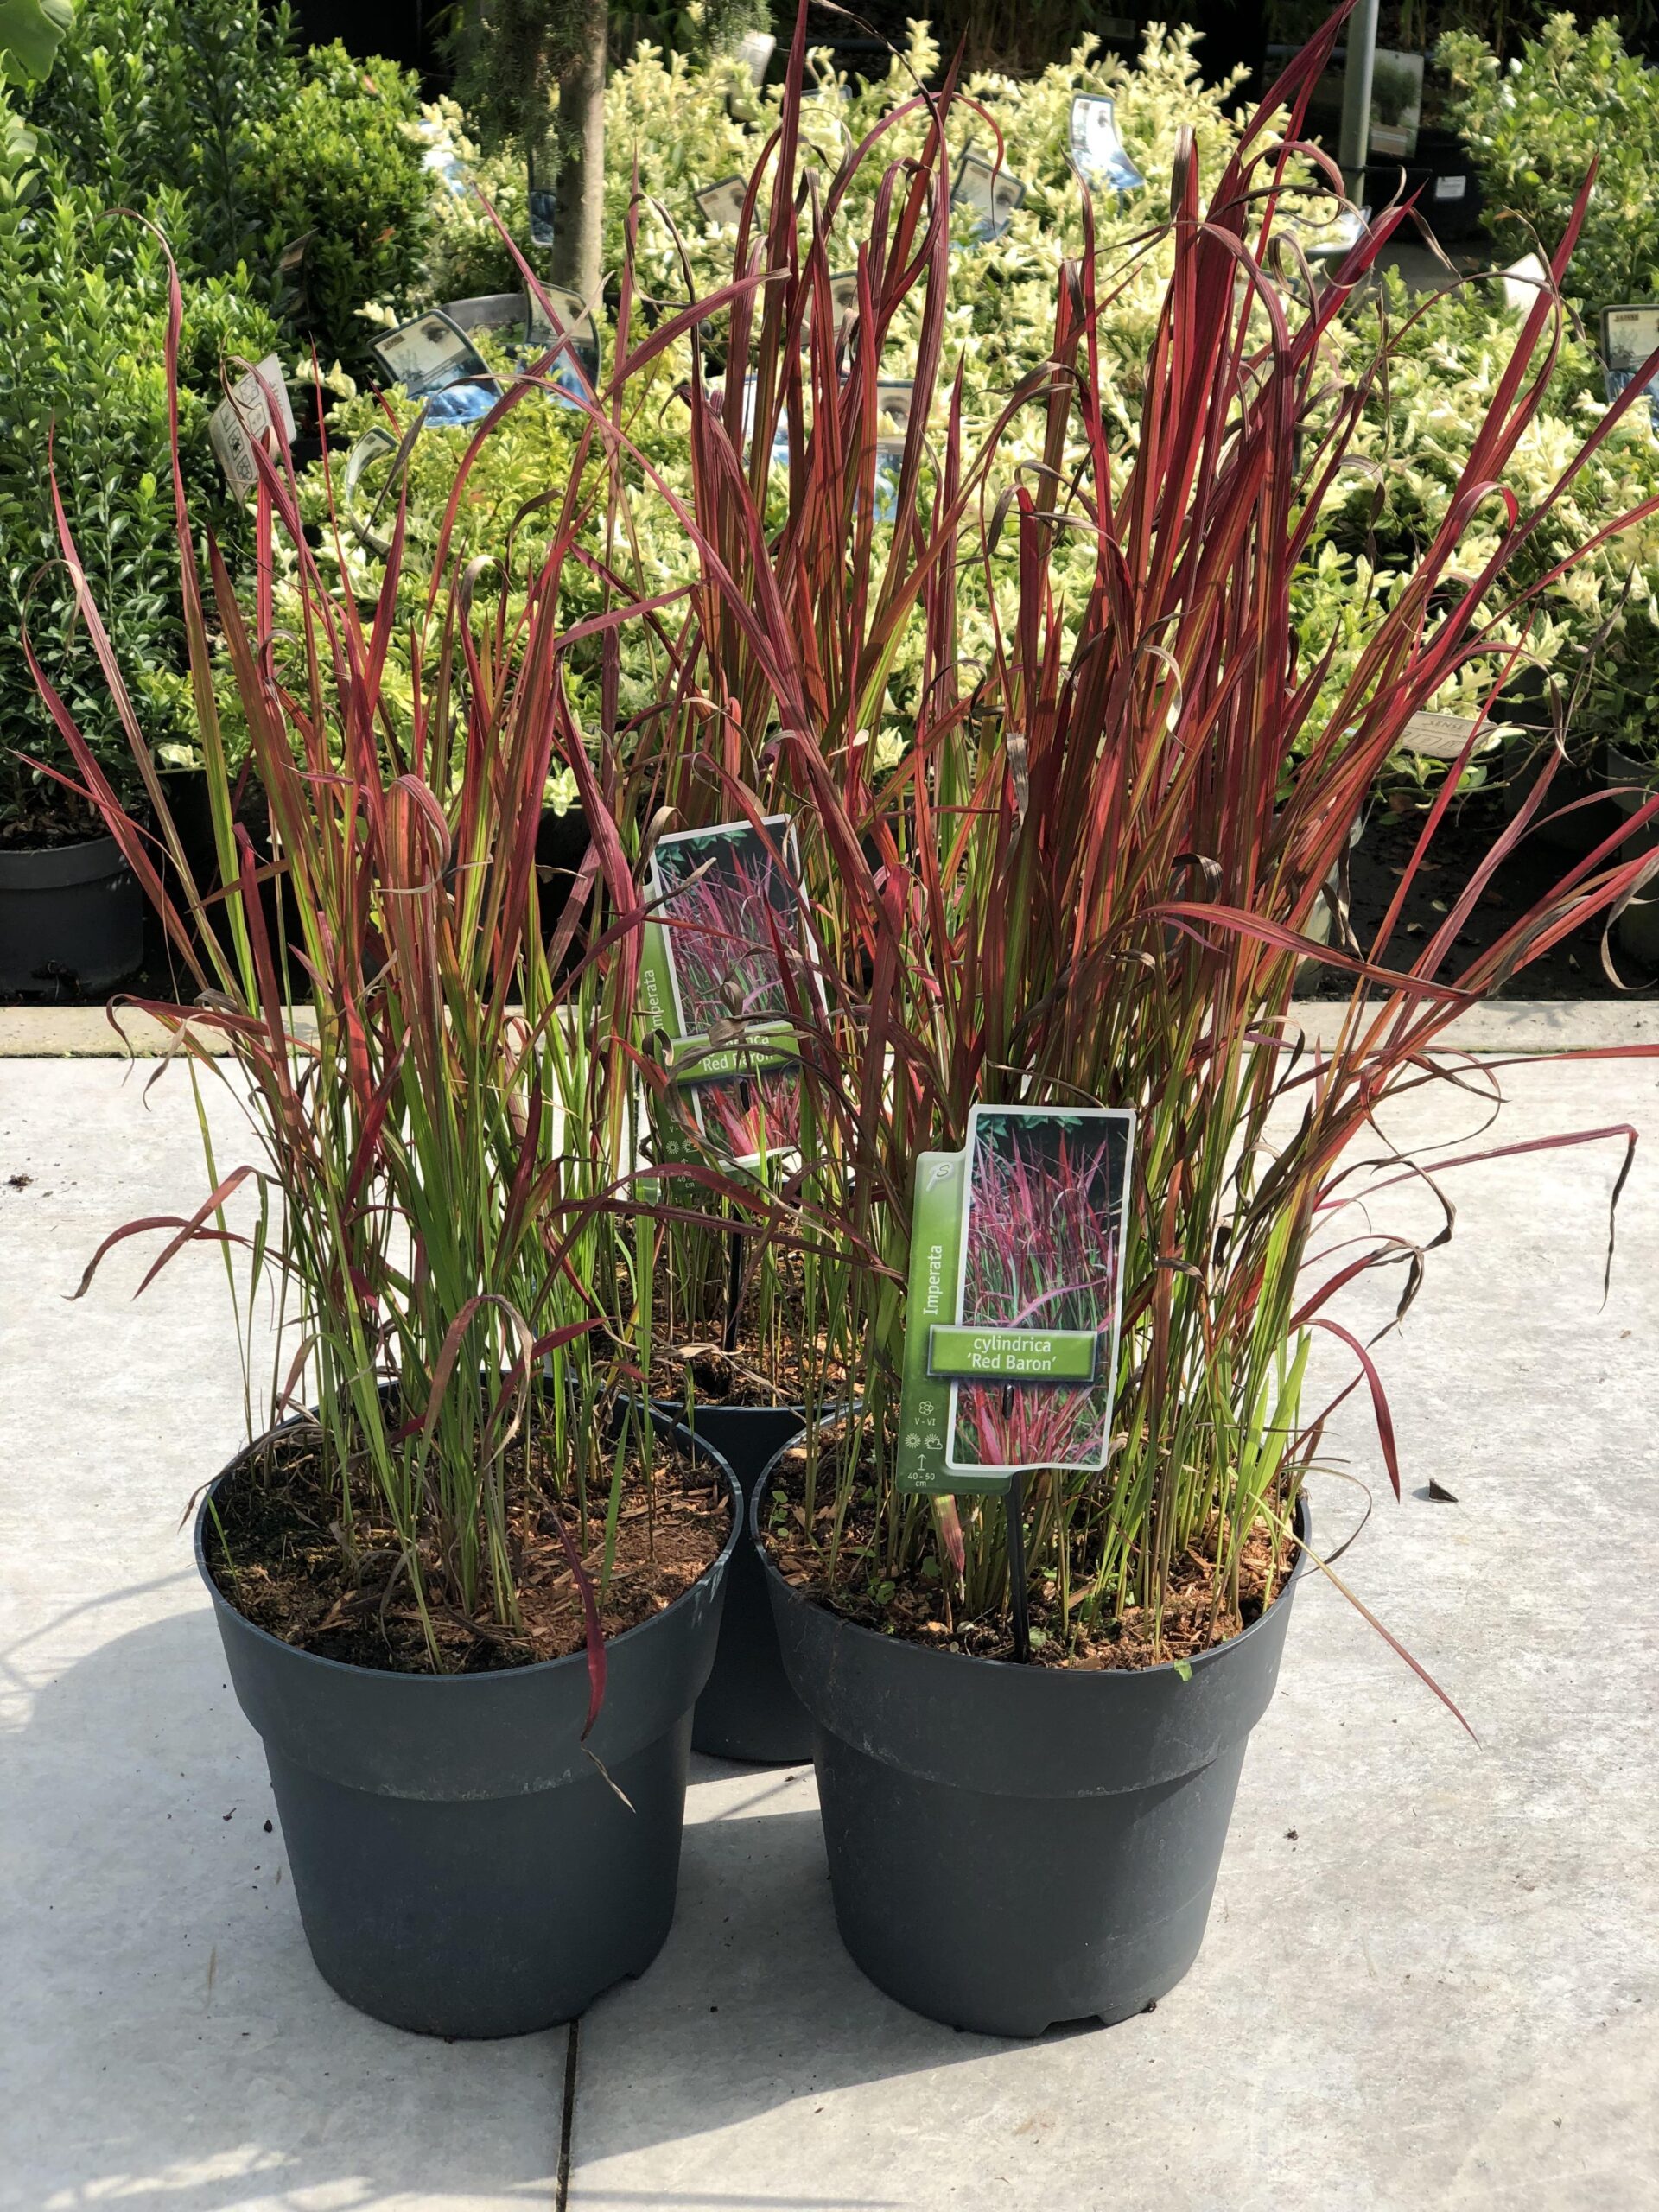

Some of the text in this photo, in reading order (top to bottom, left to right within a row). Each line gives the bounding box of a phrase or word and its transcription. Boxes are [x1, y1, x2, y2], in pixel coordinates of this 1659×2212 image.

[923, 1245, 944, 1315] Imperata
[973, 1334, 1052, 1354] cylindrica
[914, 1417, 920, 1426] V
[926, 1418, 936, 1427] VI
